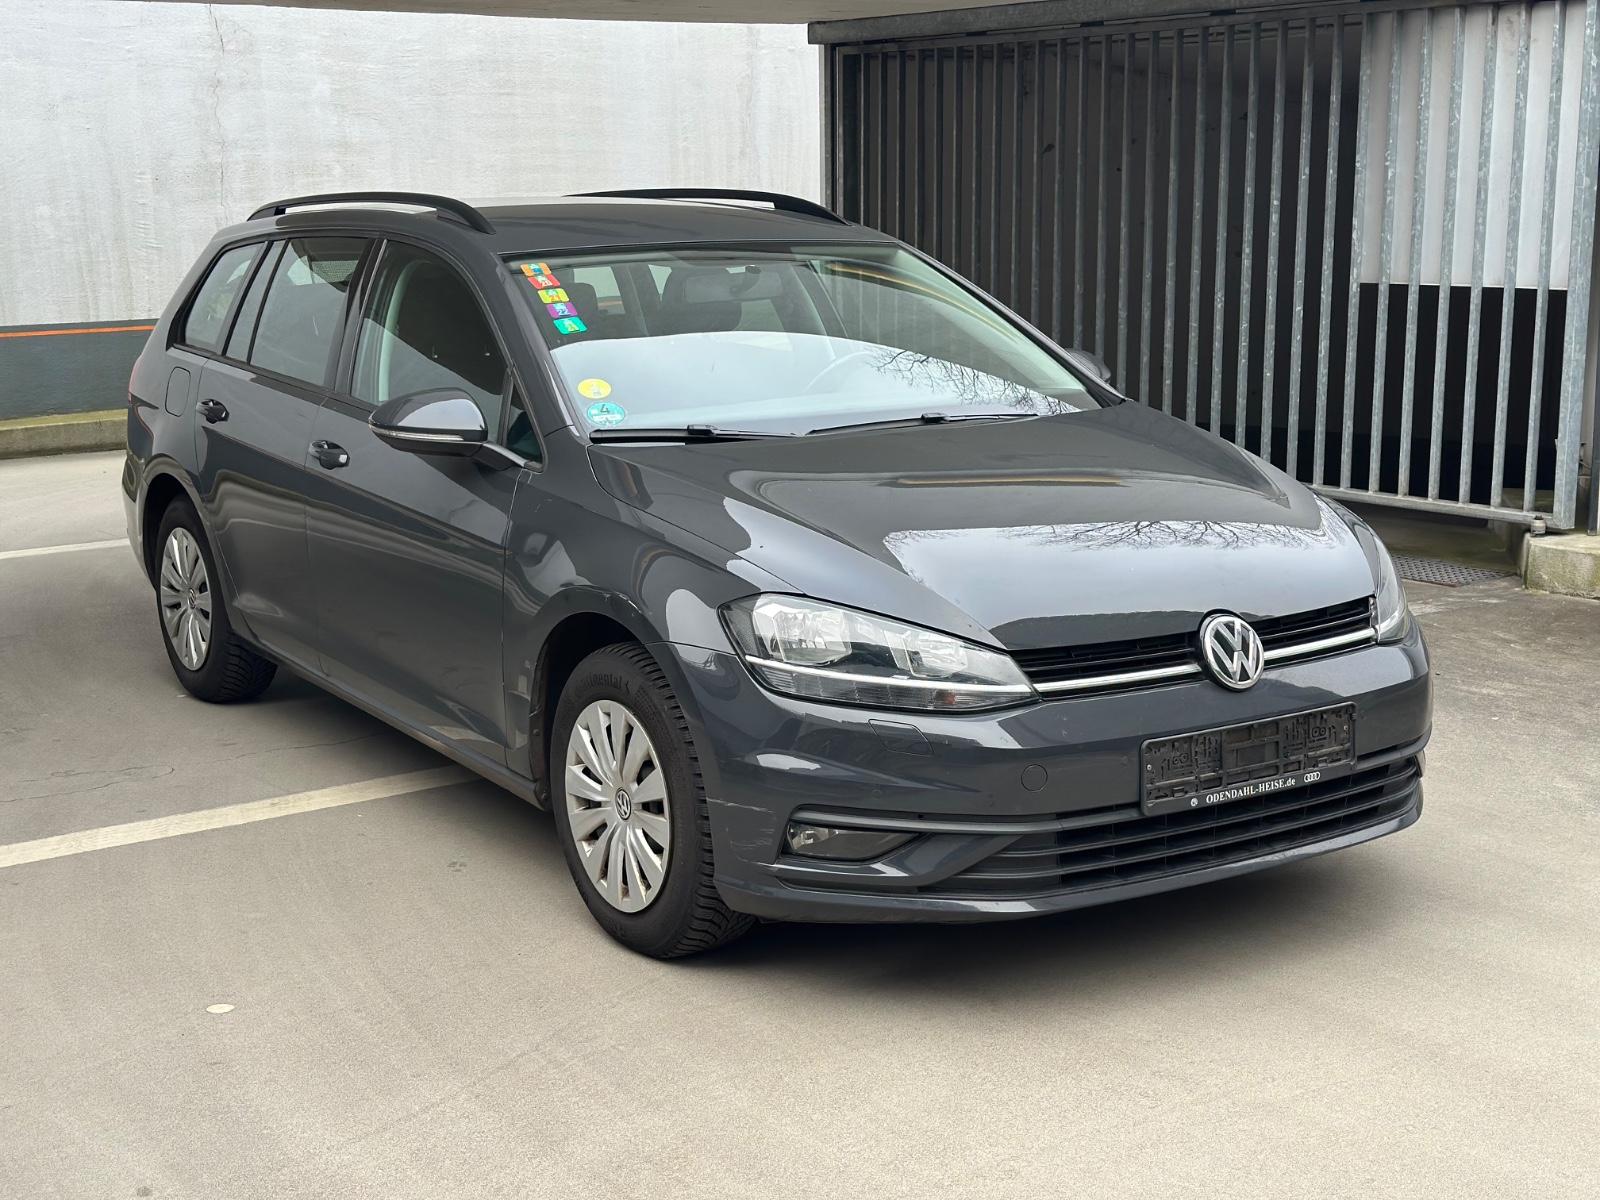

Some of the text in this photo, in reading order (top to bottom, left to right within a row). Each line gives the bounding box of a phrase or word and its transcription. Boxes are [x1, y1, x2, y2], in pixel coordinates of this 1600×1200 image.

[600, 403, 609, 413] 4
[1208, 617, 1260, 685] VW
[1206, 777, 1296, 804] ODENDAHL-HEISE.de
